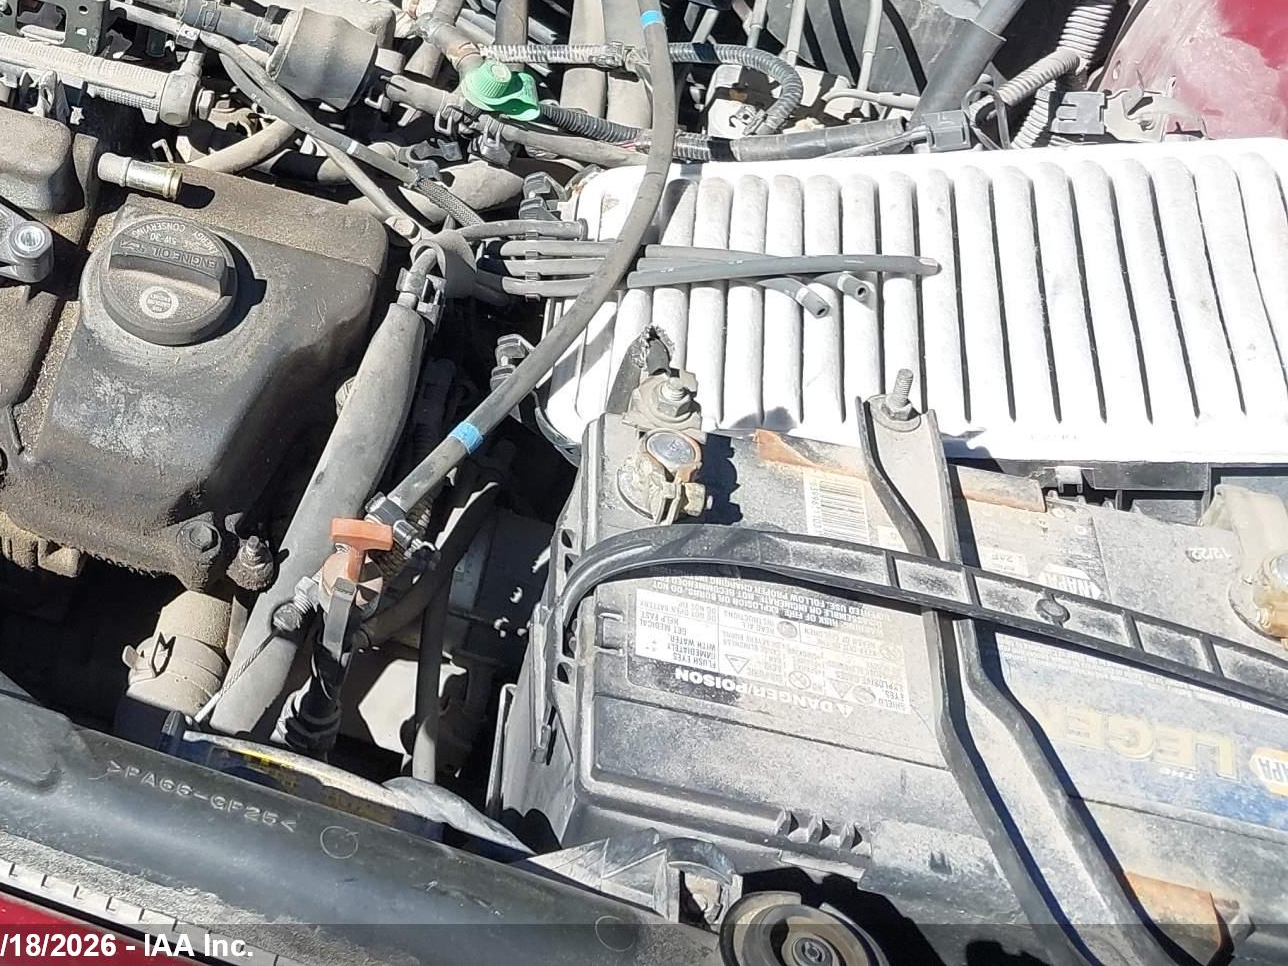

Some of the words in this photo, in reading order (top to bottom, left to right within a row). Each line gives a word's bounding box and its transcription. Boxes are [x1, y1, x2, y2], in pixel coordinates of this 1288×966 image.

[130, 221, 185, 237] CONSERVING
[149, 231, 177, 245] 5W-30
[191, 229, 218, 253] ENERGY
[151, 246, 170, 258] OIL
[172, 250, 216, 269] ENGINE
[753, 585, 788, 599] PROPER
[789, 592, 825, 607] FOLLOW
[637, 617, 670, 631] MEDICAL
[660, 614, 678, 625] HELP
[666, 642, 716, 660] IMMEDIATELY
[693, 655, 716, 668] FLUSH
[1158, 766, 1196, 780] THE
